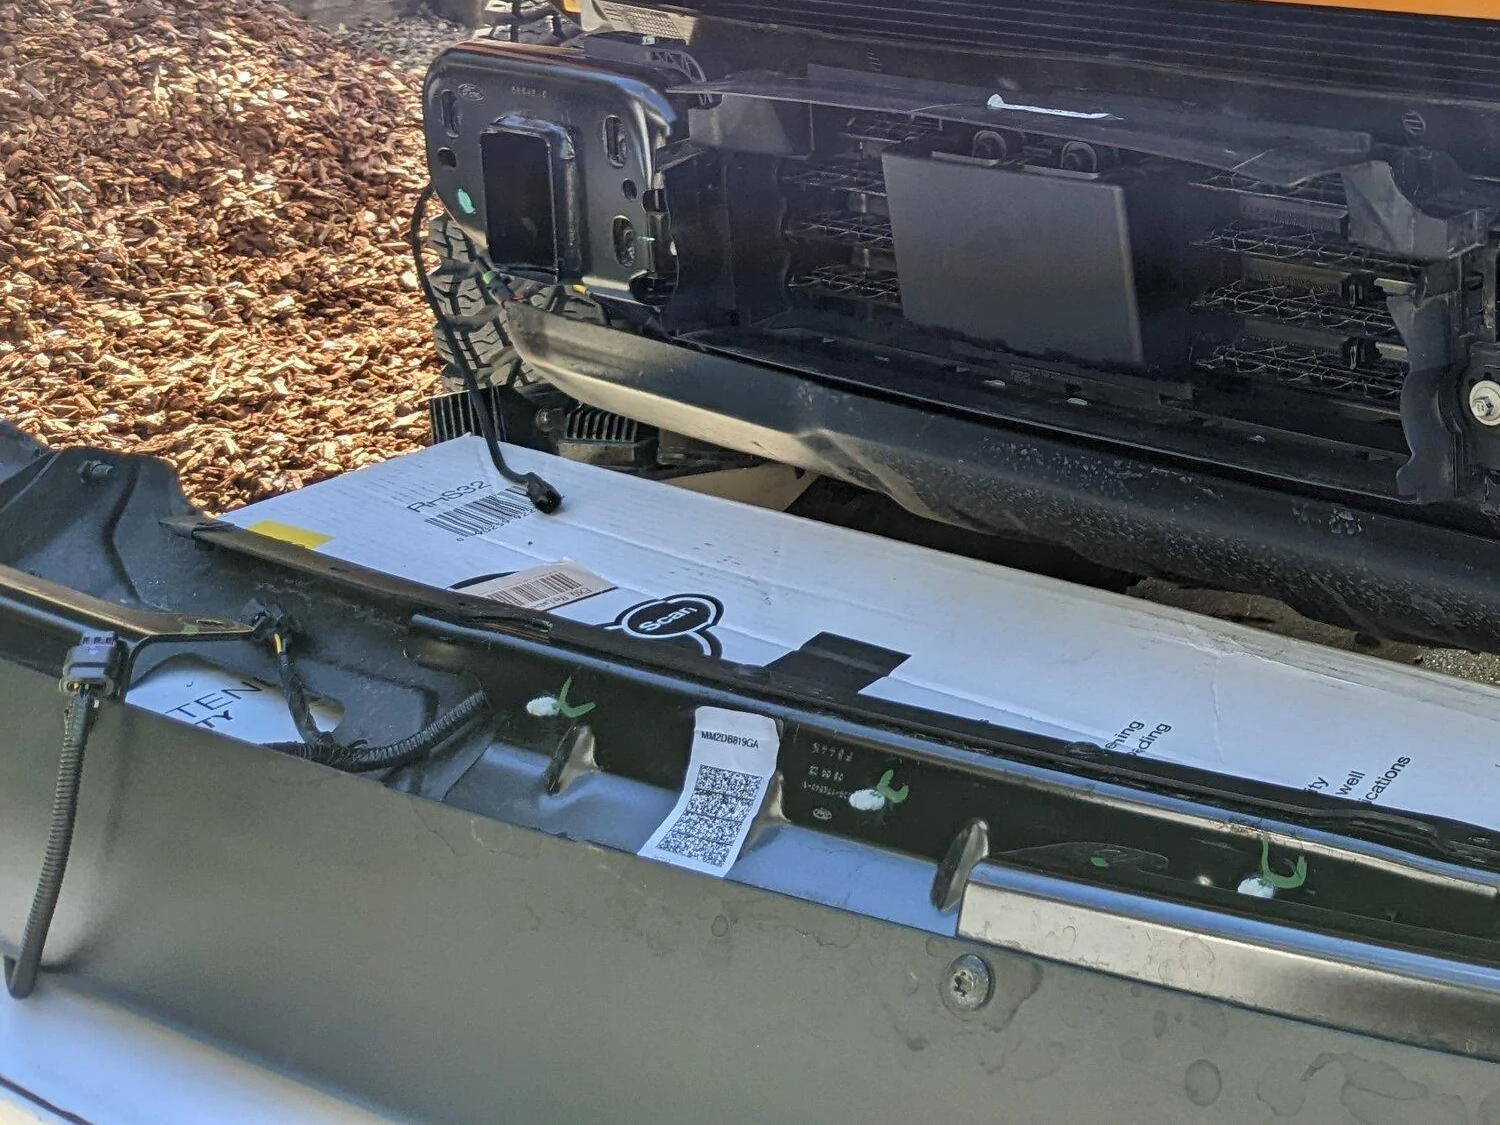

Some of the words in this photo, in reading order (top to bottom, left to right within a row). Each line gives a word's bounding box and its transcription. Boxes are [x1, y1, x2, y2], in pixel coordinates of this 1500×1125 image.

[637, 605, 699, 632] Scan
[165, 677, 279, 718] TEN
[1127, 723, 1173, 756] ding
[1335, 770, 1366, 795] well
